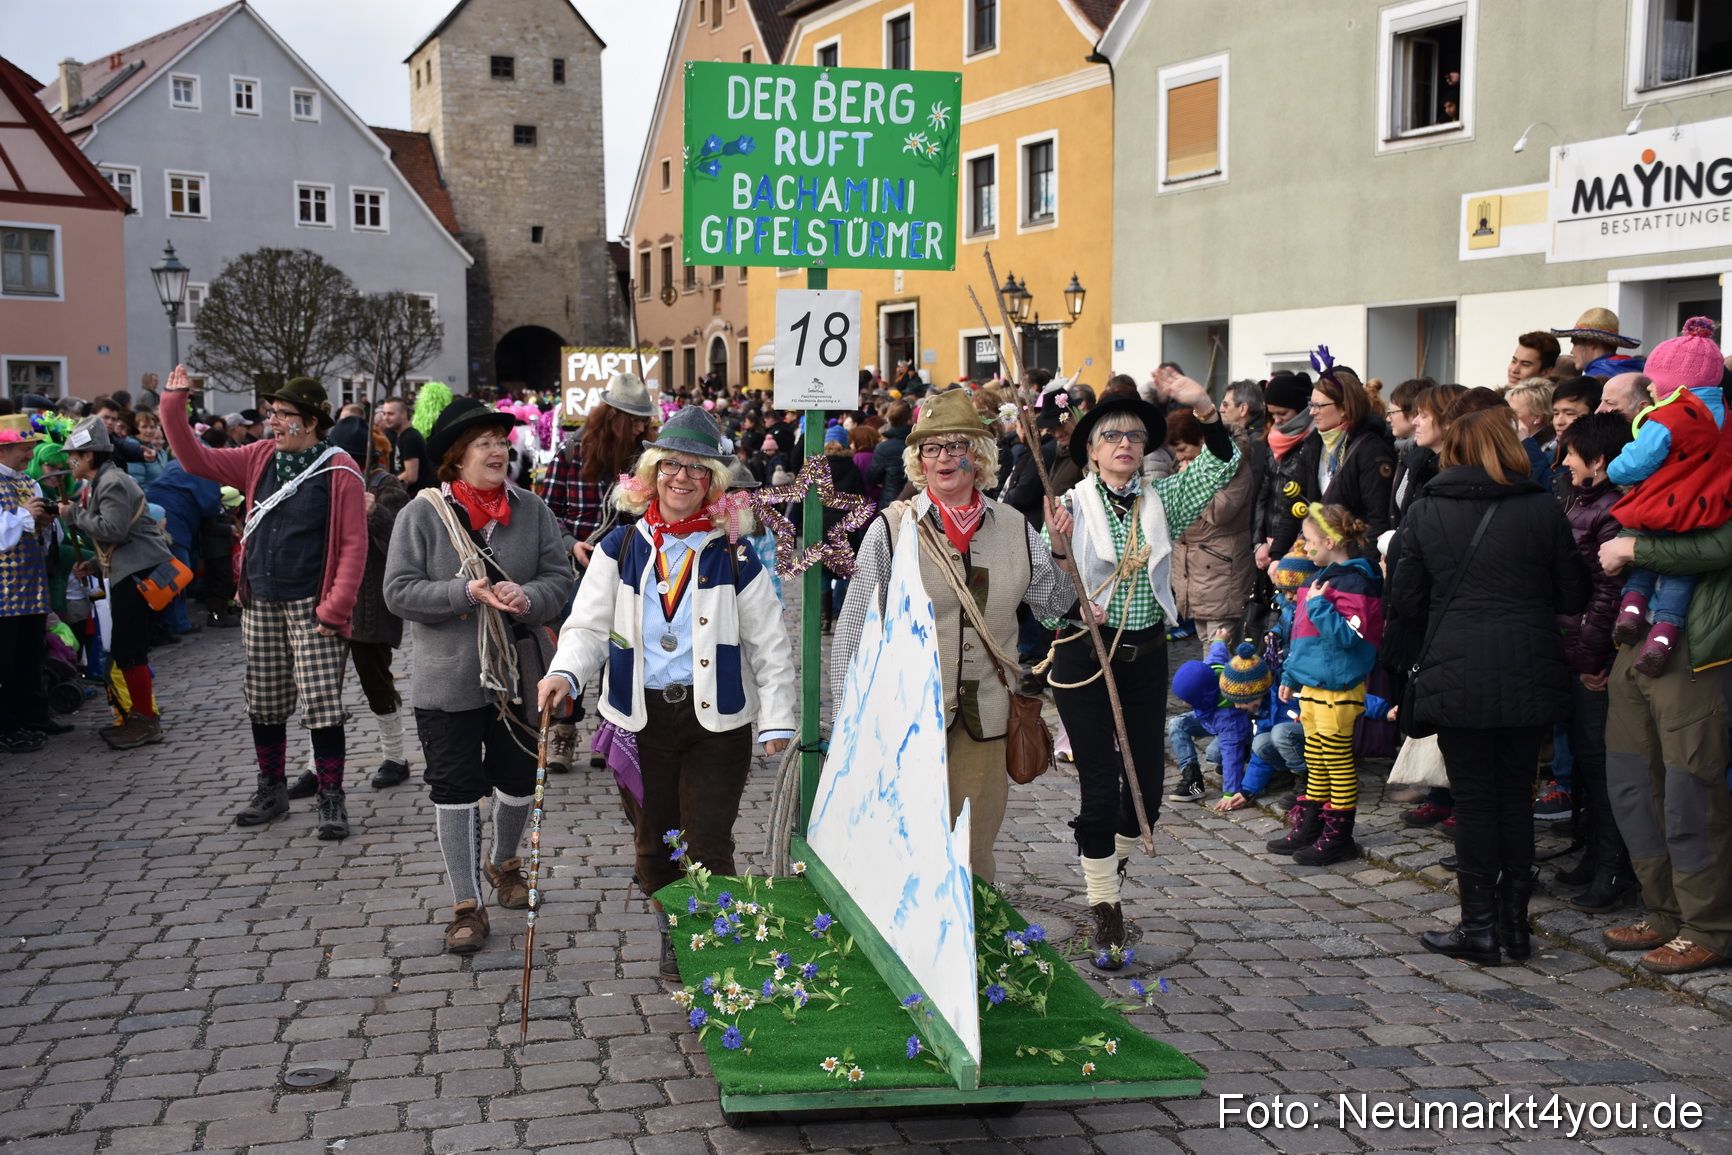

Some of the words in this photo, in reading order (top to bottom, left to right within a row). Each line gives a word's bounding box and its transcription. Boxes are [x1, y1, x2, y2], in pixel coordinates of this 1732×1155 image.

[727, 75, 797, 121] DER
[812, 80, 915, 125] BERG
[774, 127, 873, 167] RUFT
[733, 172, 915, 215] BACHAMINI
[700, 214, 943, 260] GIPFELSTÜRMER
[1601, 207, 1731, 235] BESTATTUNGE
[789, 311, 850, 367] 18
[567, 352, 659, 382] PARTY
